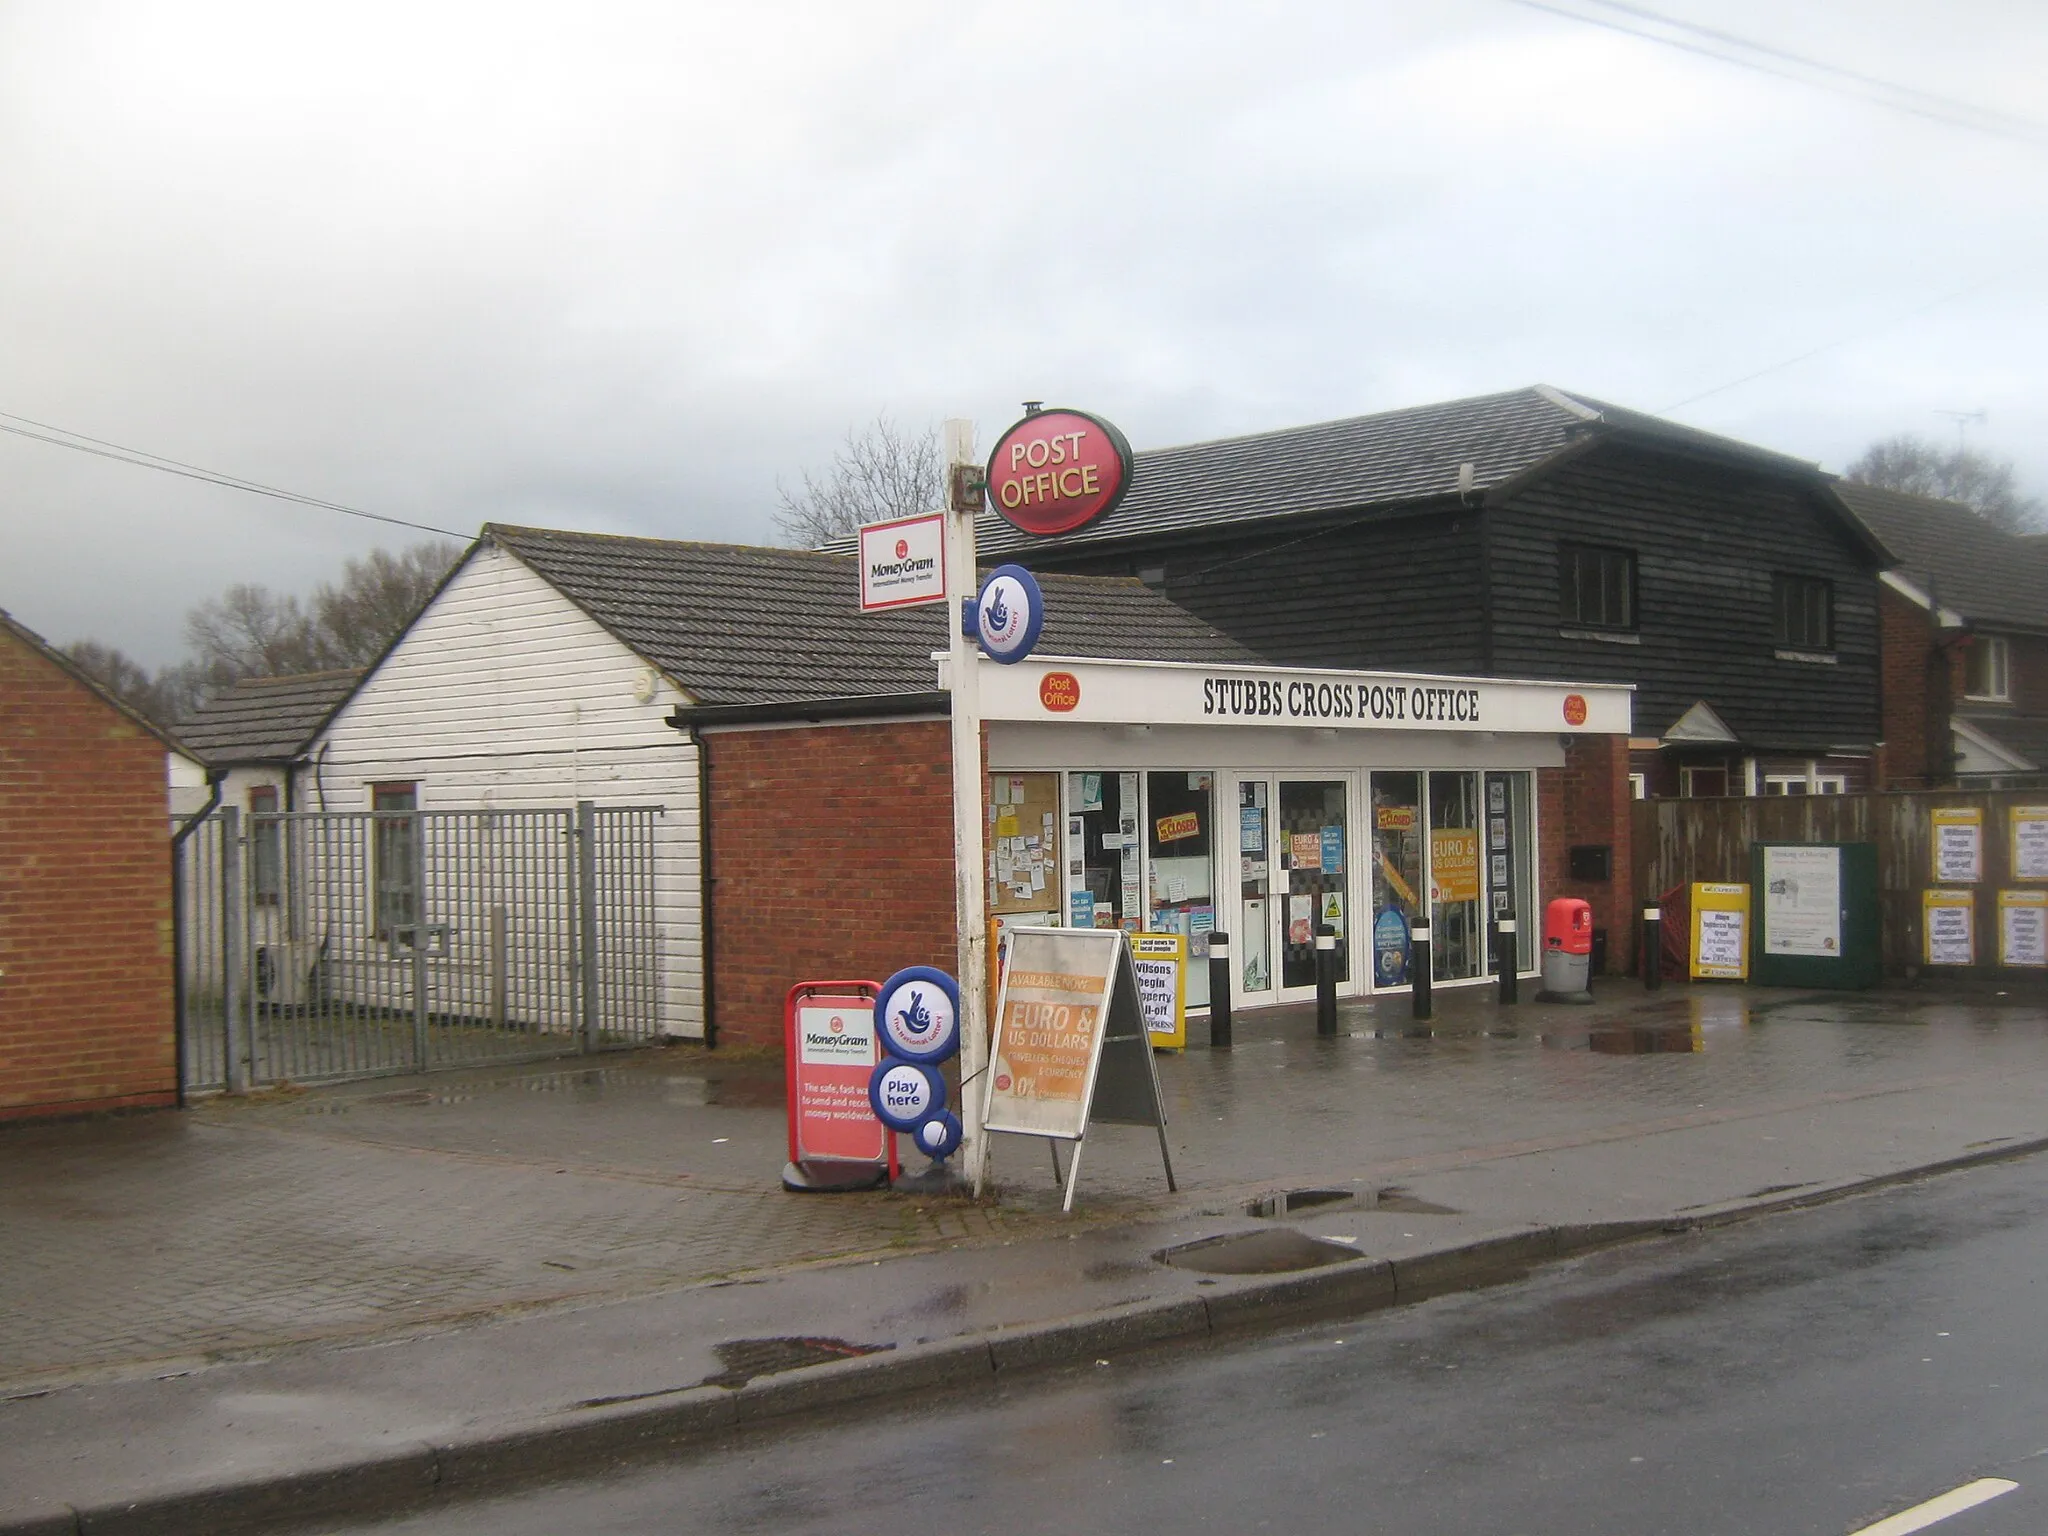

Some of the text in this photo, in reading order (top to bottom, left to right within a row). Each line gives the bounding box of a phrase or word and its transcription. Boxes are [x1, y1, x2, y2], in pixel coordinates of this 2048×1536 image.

[1011, 431, 1086, 472] POST
[1001, 464, 1100, 508] OFFICE
[871, 557, 934, 578] MoneyGram
[1049, 677, 1071, 690] Post
[1044, 692, 1076, 705] Office
[1204, 678, 1479, 721] STUBBS CROSS POST OFFICE
[1168, 819, 1196, 835] CLOSED
[1386, 814, 1410, 826] CLOSED
[1432, 840, 1475, 858] EURO &
[1010, 974, 1061, 988] AVAILABLE
[1011, 1003, 1093, 1033] EURO &
[898, 1031, 929, 1046] National
[929, 1015, 943, 1041] Lottery
[806, 1033, 868, 1047] MoneyGram
[1008, 1031, 1089, 1049] US DOLLARS
[804, 1082, 819, 1093] The
[888, 1080, 919, 1094] Play
[887, 1094, 920, 1106] here
